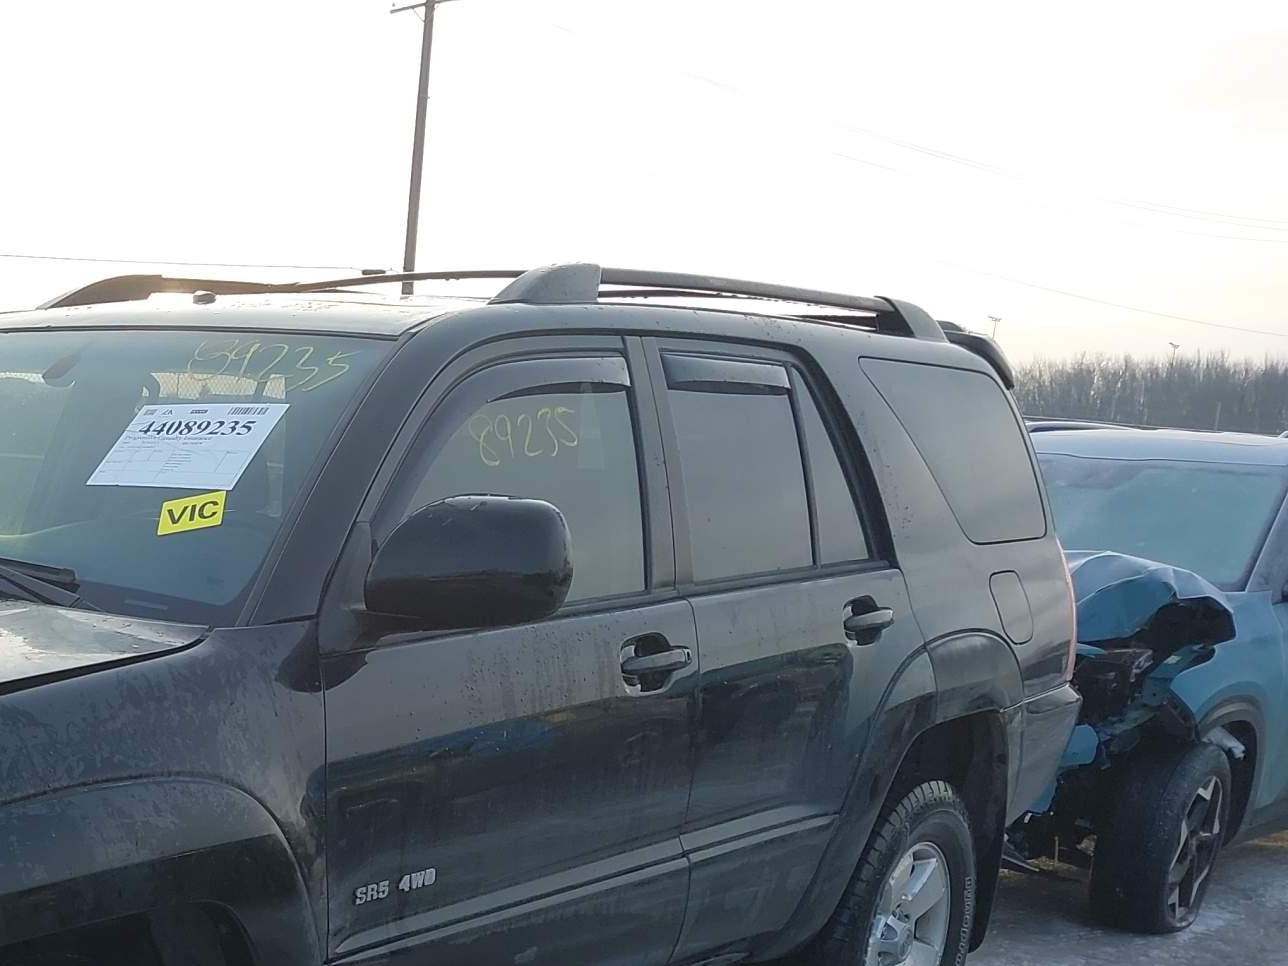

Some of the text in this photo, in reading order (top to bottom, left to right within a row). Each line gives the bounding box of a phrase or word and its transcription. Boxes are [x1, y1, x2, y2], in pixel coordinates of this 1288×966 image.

[139, 420, 256, 437] 44089235
[468, 406, 578, 466] 89235
[167, 501, 219, 524] VIC
[355, 868, 436, 905] SR5 4WD
